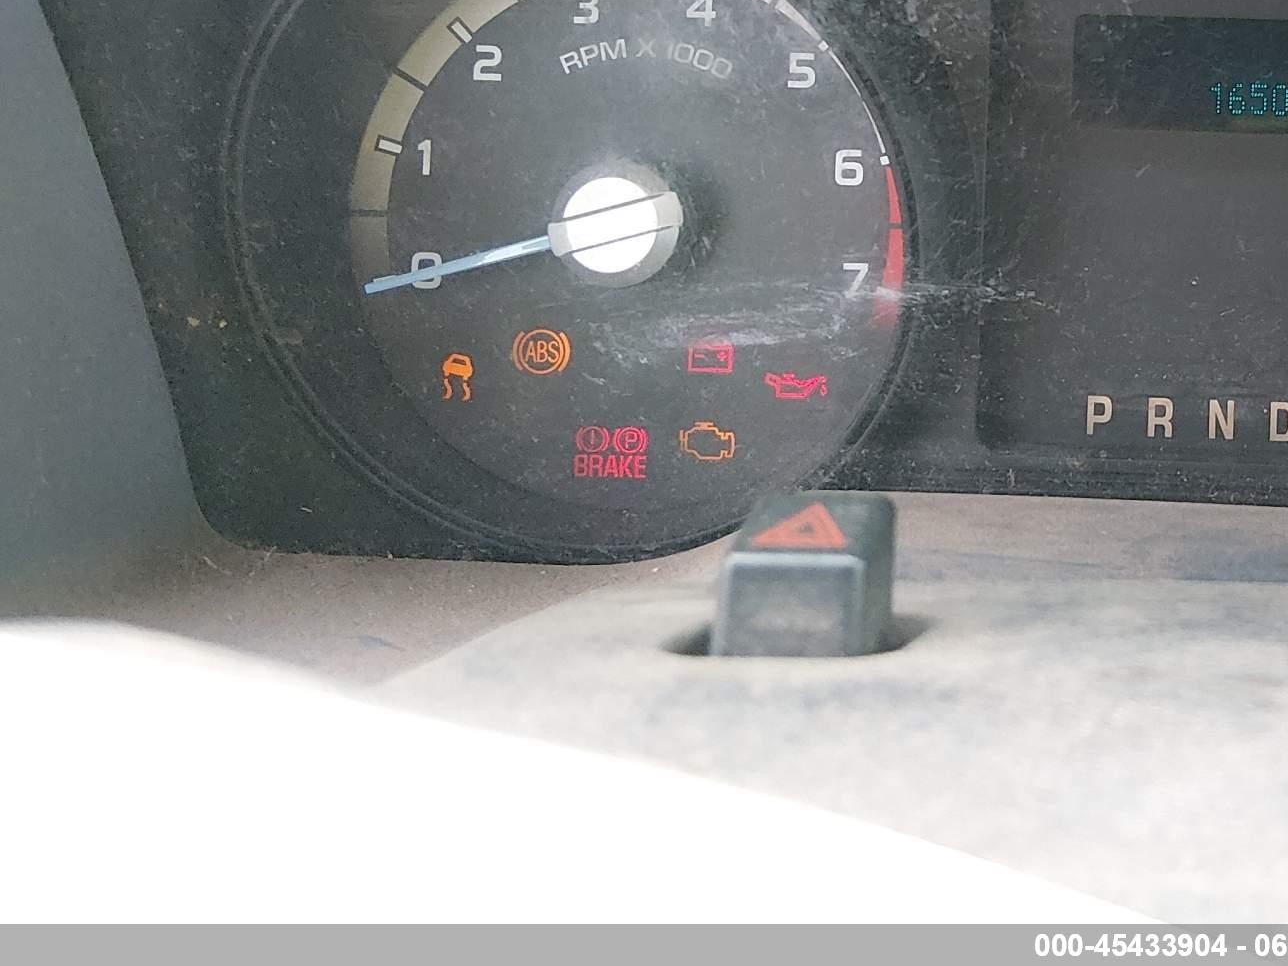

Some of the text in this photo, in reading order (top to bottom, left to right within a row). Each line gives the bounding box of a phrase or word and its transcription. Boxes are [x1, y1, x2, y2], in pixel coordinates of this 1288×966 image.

[472, 45, 503, 82] 2
[559, 38, 628, 76] RPM
[667, 42, 734, 80] 1000
[787, 53, 816, 89] 5
[416, 139, 432, 176] 1
[834, 150, 864, 186] 6
[411, 251, 443, 290] 0
[843, 263, 870, 296] 7
[525, 340, 560, 364] ABS
[1086, 395, 1114, 435] P
[1146, 396, 1174, 438] R
[1207, 399, 1236, 440] N
[573, 454, 648, 479] BRAKE
